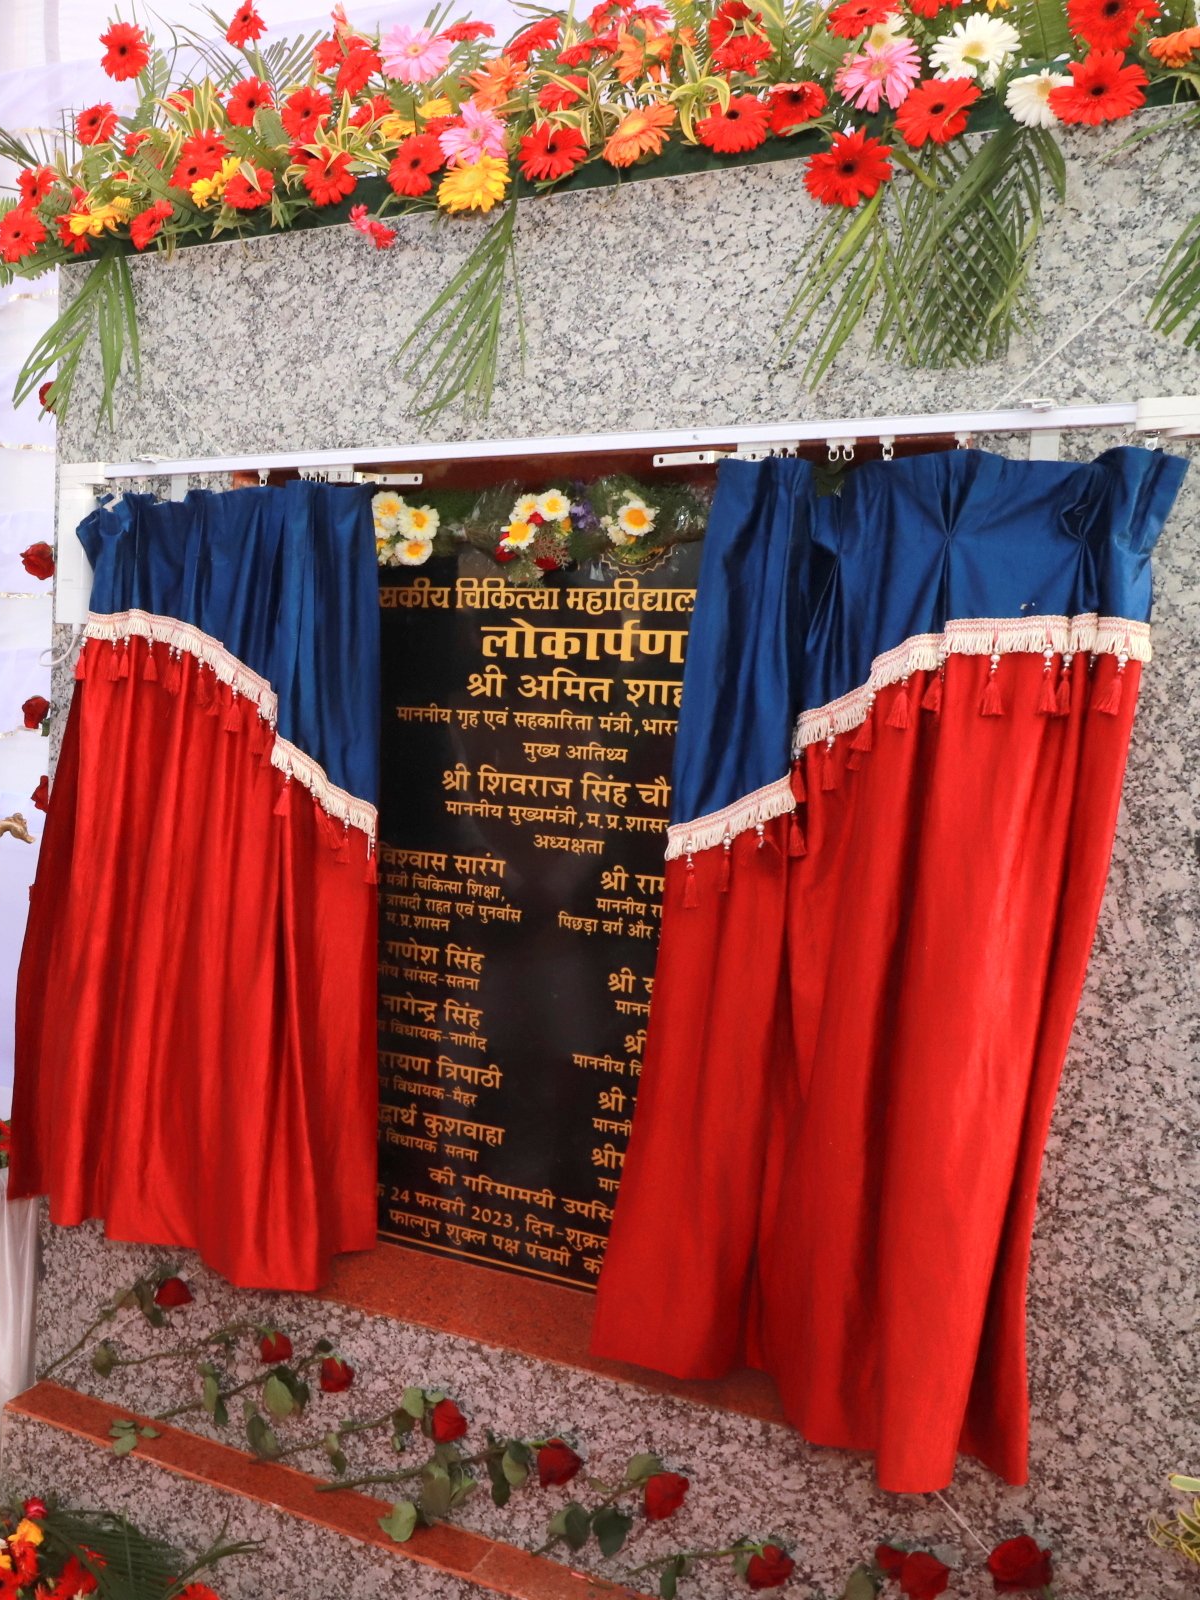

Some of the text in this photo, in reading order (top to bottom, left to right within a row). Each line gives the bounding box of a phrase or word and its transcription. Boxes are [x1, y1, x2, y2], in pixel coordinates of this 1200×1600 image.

[379, 577, 697, 616] सकीय चिकित्सा महाविद्याल
[481, 617, 689, 663] लोकार्पण
[466, 664, 508, 698] श्री
[517, 667, 614, 703] अमित
[396, 703, 452, 724] माननीय
[456, 709, 481, 730] गृह
[483, 706, 509, 731] एवं
[512, 709, 593, 731] सहकारिता
[522, 741, 629, 763] मुख्य आतिथ्य
[442, 762, 673, 808] श्री शिवराज सिंह चौ
[445, 799, 502, 819] माननीय
[585, 812, 670, 834] म.प्र.शास
[533, 834, 605, 856] अध्यक्षता
[453, 852, 506, 878] सारंग
[600, 865, 629, 892] श्री
[386, 871, 408, 889] मंत्री
[412, 871, 463, 896] चिकित्सा
[386, 892, 422, 912] त्रासदी
[425, 898, 452, 915] राहत
[455, 900, 475, 919] एवं
[478, 903, 522, 924] पुनर्वास
[596, 896, 646, 917] माननीय
[558, 911, 599, 936] पिछड़ा
[602, 917, 624, 936] वर्ग
[628, 919, 654, 940] और
[386, 936, 486, 975] गणेश सिंह
[608, 967, 637, 994] श्री
[381, 991, 484, 1030] नागेन्द्र सिंह
[378, 1050, 503, 1090] रायण त्रिपाठी
[572, 1053, 626, 1075] माननीय
[598, 1086, 627, 1113] श्री
[422, 1111, 506, 1148] कुशवाहा
[592, 1117, 633, 1137] माननी
[386, 1128, 438, 1154] विधायक
[444, 1143, 479, 1163] सतना
[390, 1186, 411, 1204] 24
[415, 1191, 466, 1217] फरवरी
[428, 1166, 457, 1187] की
[461, 1174, 557, 1210] गरिमामयी
[389, 1208, 441, 1237] फाल्गुन
[445, 1221, 487, 1246] शुक्ल
[492, 1232, 521, 1257] पक्ष
[525, 1239, 572, 1268] पंचमी
